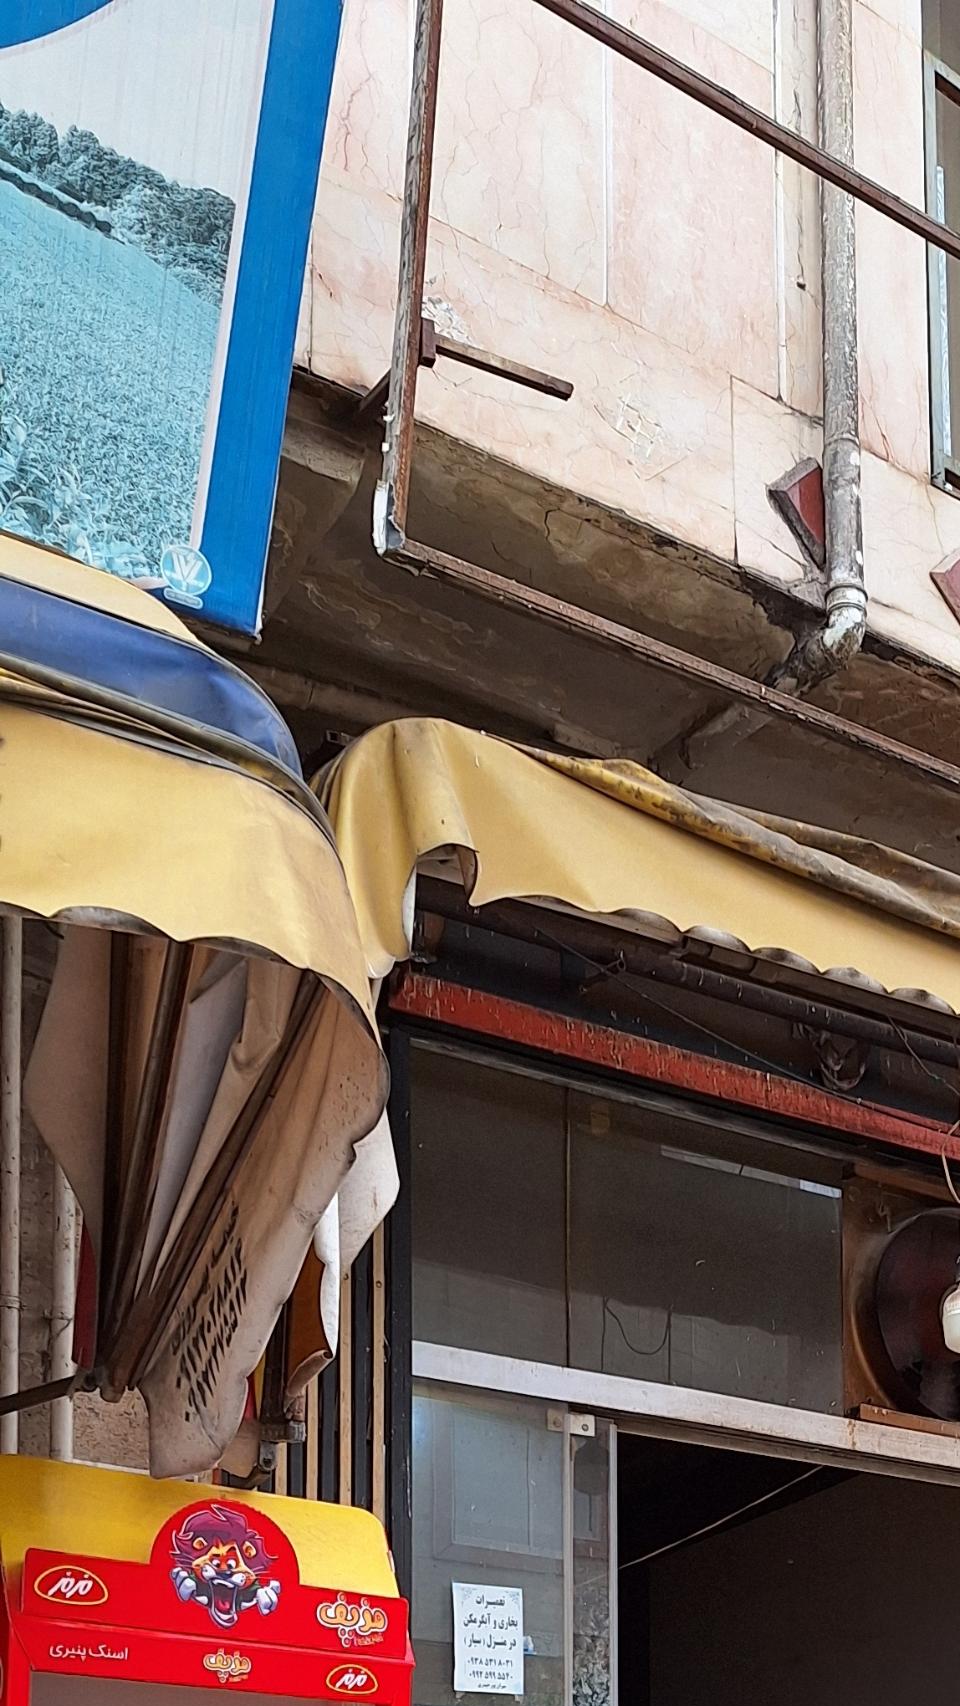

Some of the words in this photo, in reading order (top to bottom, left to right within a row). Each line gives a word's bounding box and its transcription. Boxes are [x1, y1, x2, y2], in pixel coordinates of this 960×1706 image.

[498, 1615, 519, 1631] بخاری
[486, 1633, 507, 1650] منزل
[508, 1638, 517, 1650] در
[49, 1642, 87, 1663] پنیری
[88, 1643, 129, 1661] اسنک
